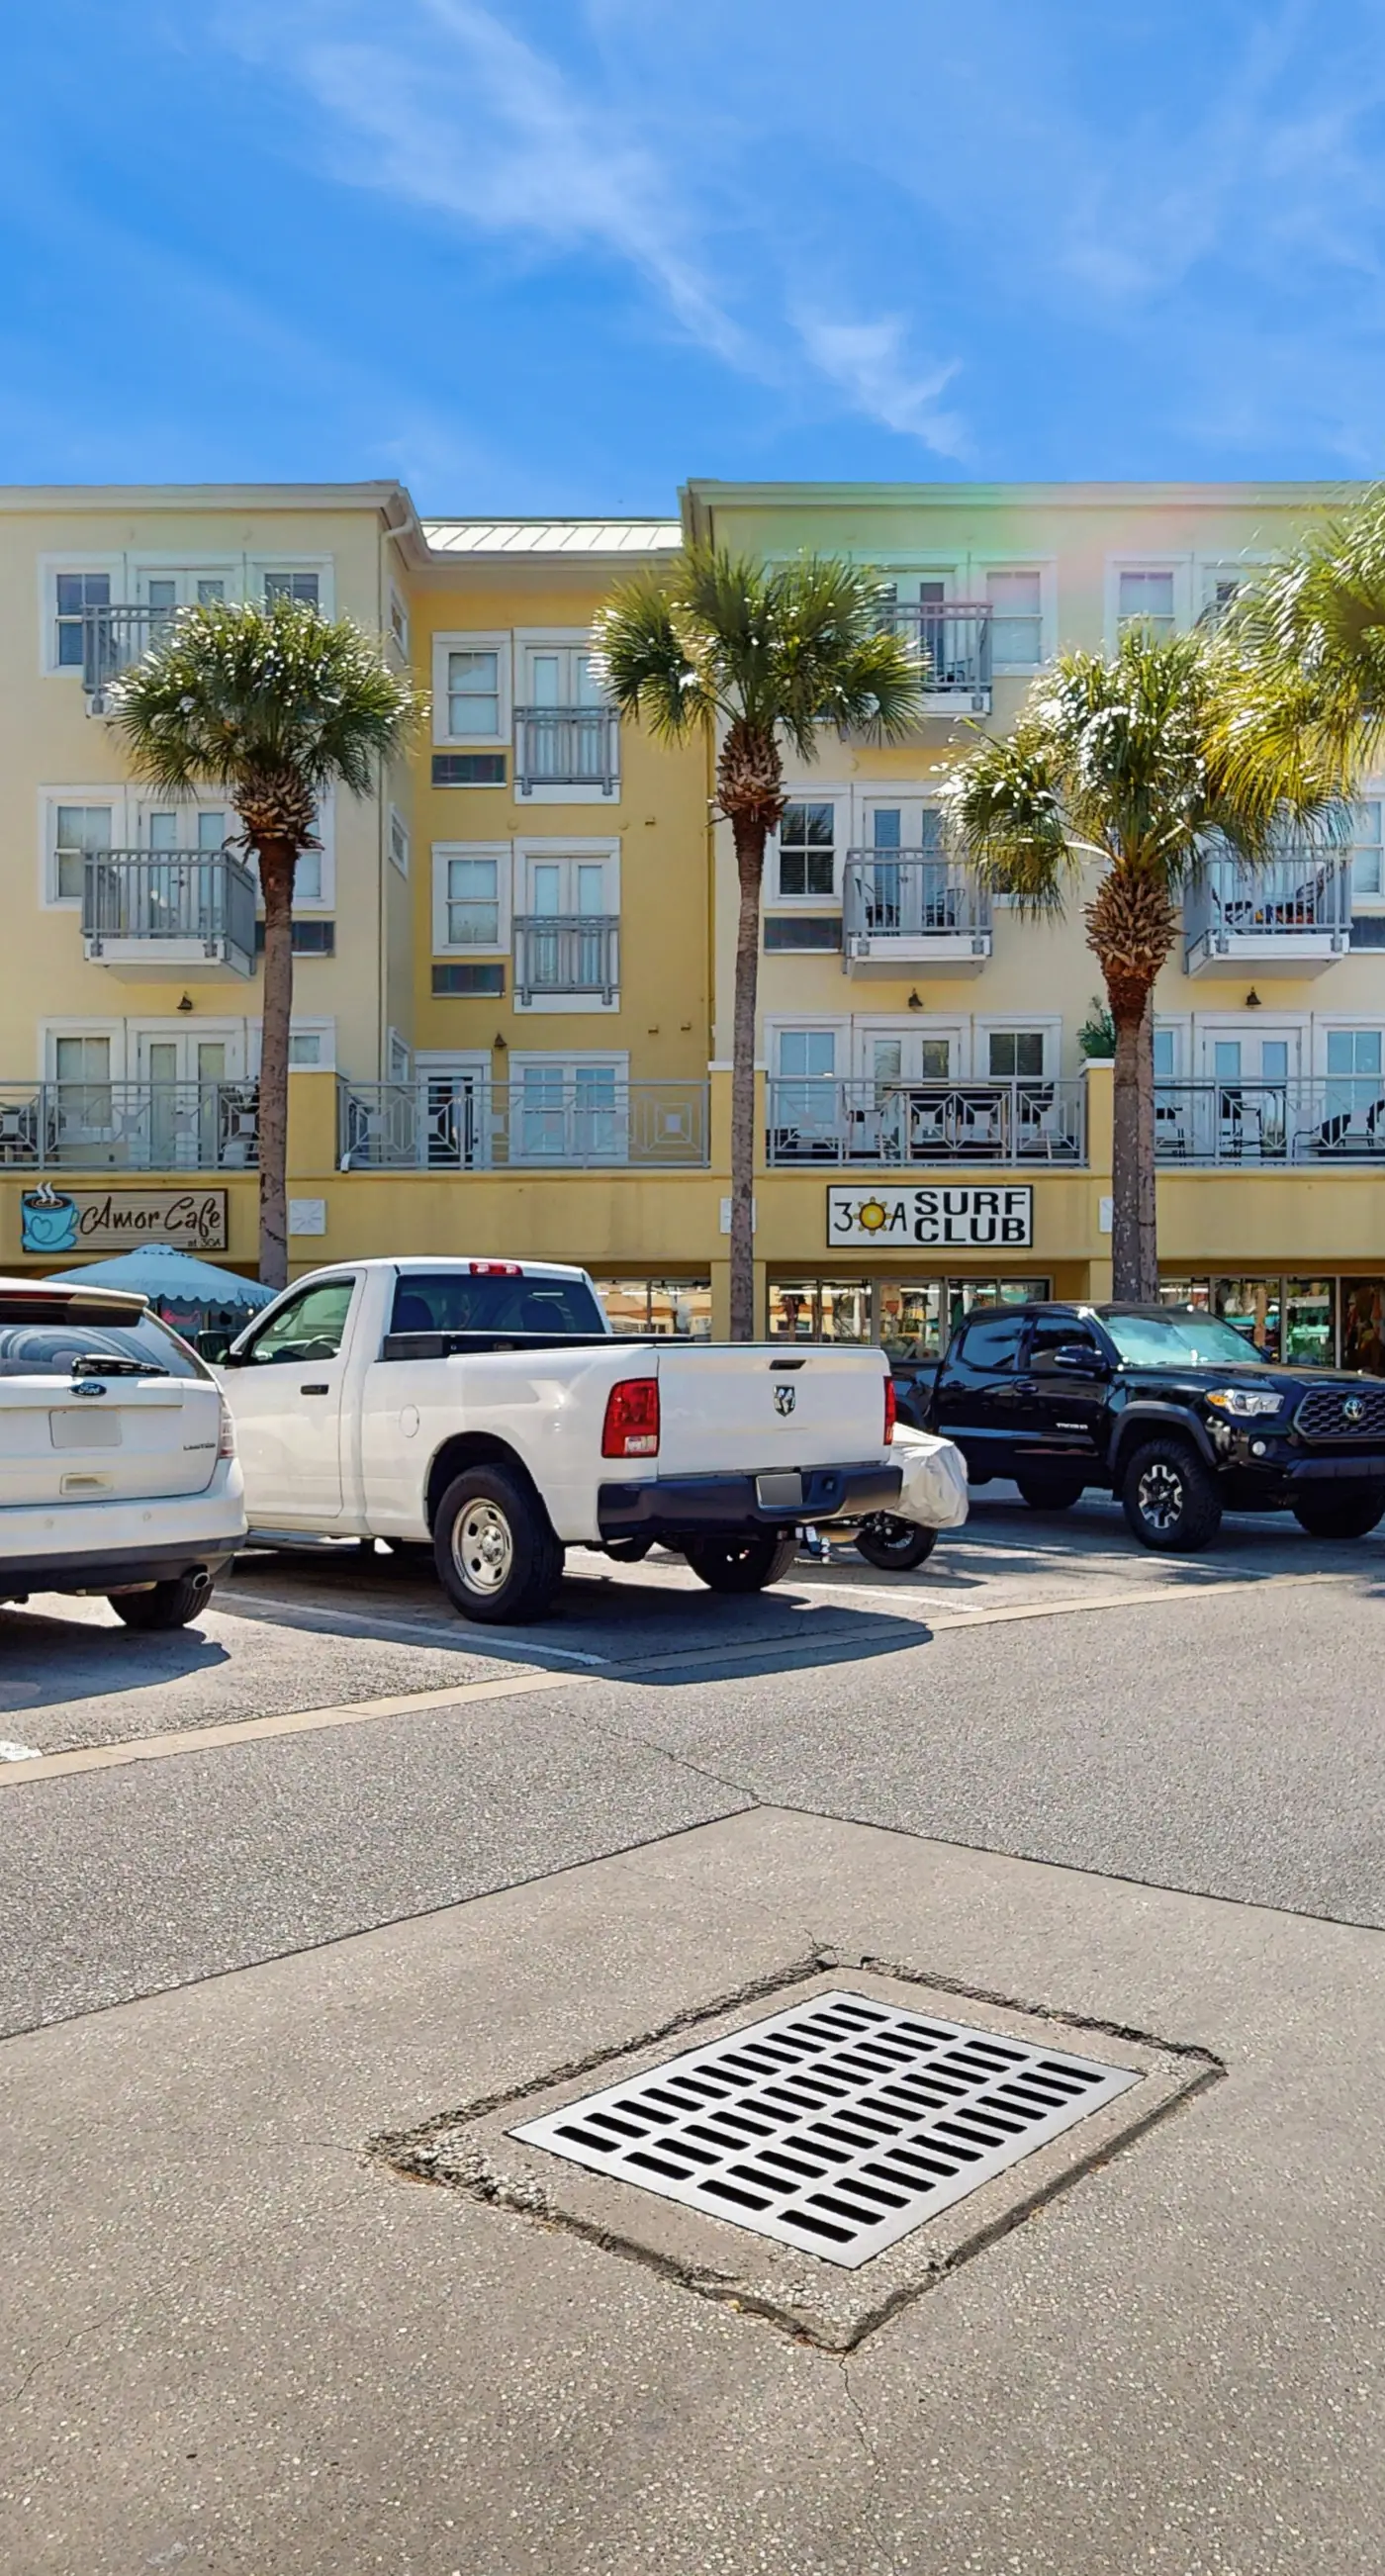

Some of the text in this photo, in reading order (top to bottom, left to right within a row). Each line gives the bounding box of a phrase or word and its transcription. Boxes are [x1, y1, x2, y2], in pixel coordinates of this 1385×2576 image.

[914, 1191, 1026, 1215] SURF
[80, 1196, 221, 1238] Amor Cafe
[914, 1218, 1026, 1242] CLUB
